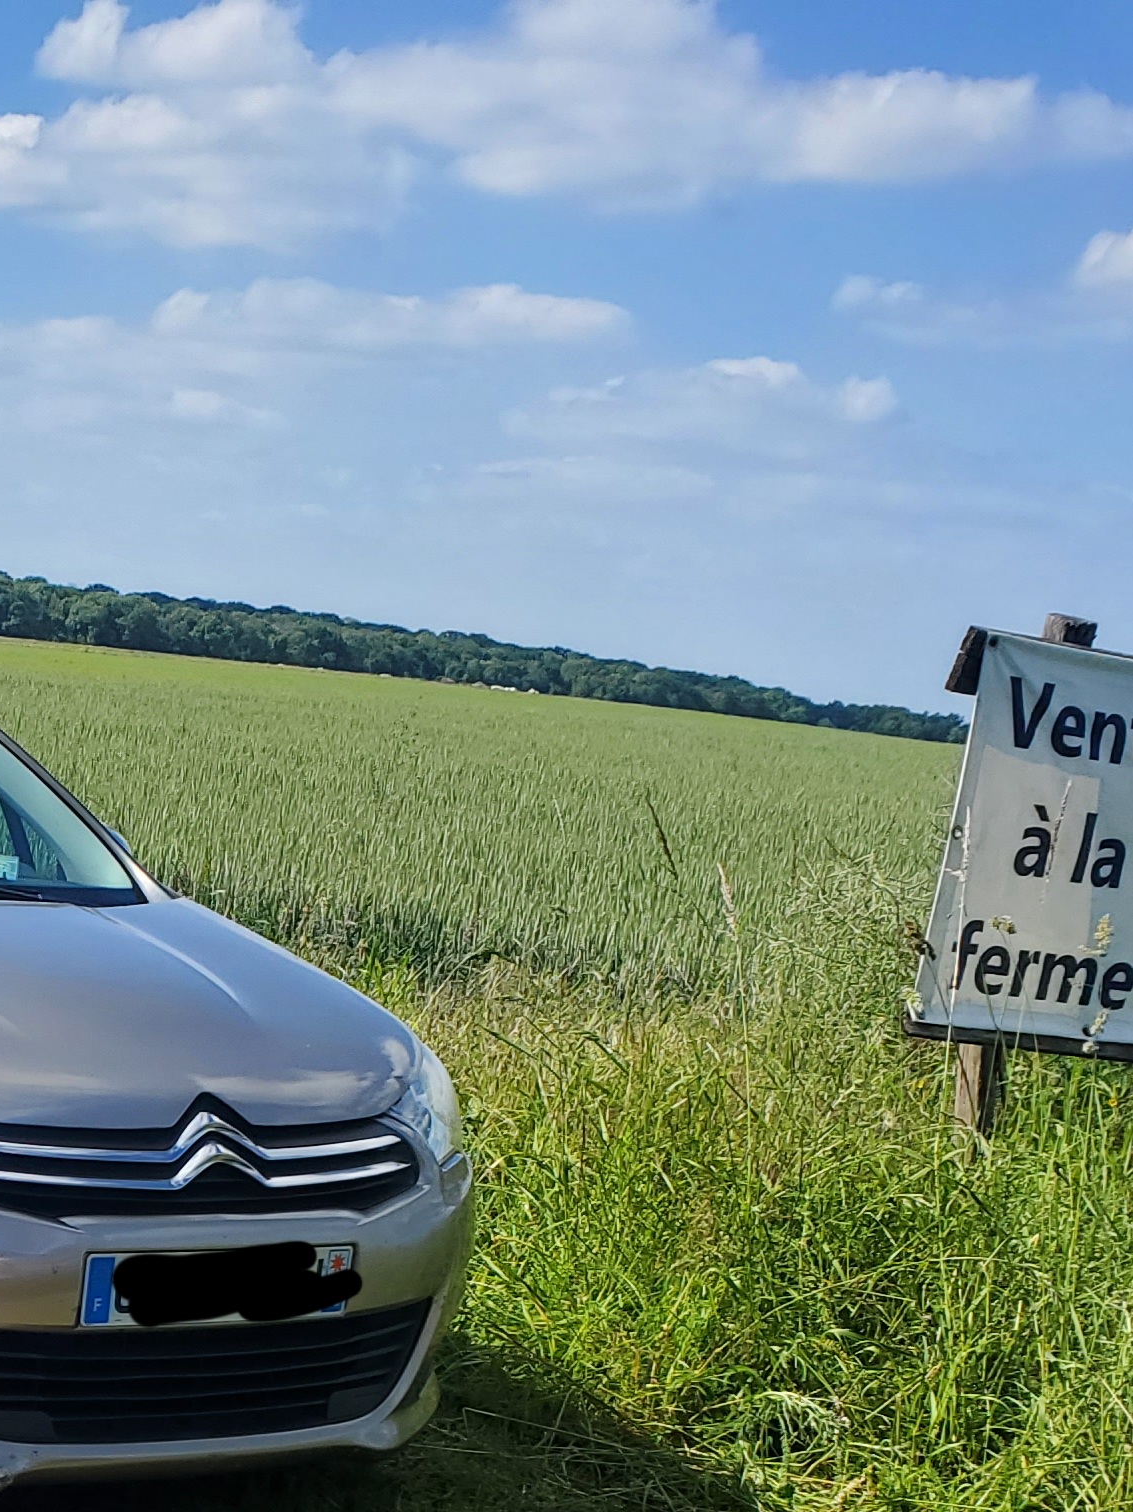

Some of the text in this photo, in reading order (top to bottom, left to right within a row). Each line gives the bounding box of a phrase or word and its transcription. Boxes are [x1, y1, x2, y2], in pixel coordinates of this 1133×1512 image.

[1010, 676, 1133, 765] Ven
[1013, 804, 1126, 889] à la
[949, 919, 1133, 1010] ferme
[92, 1297, 103, 1312] F
